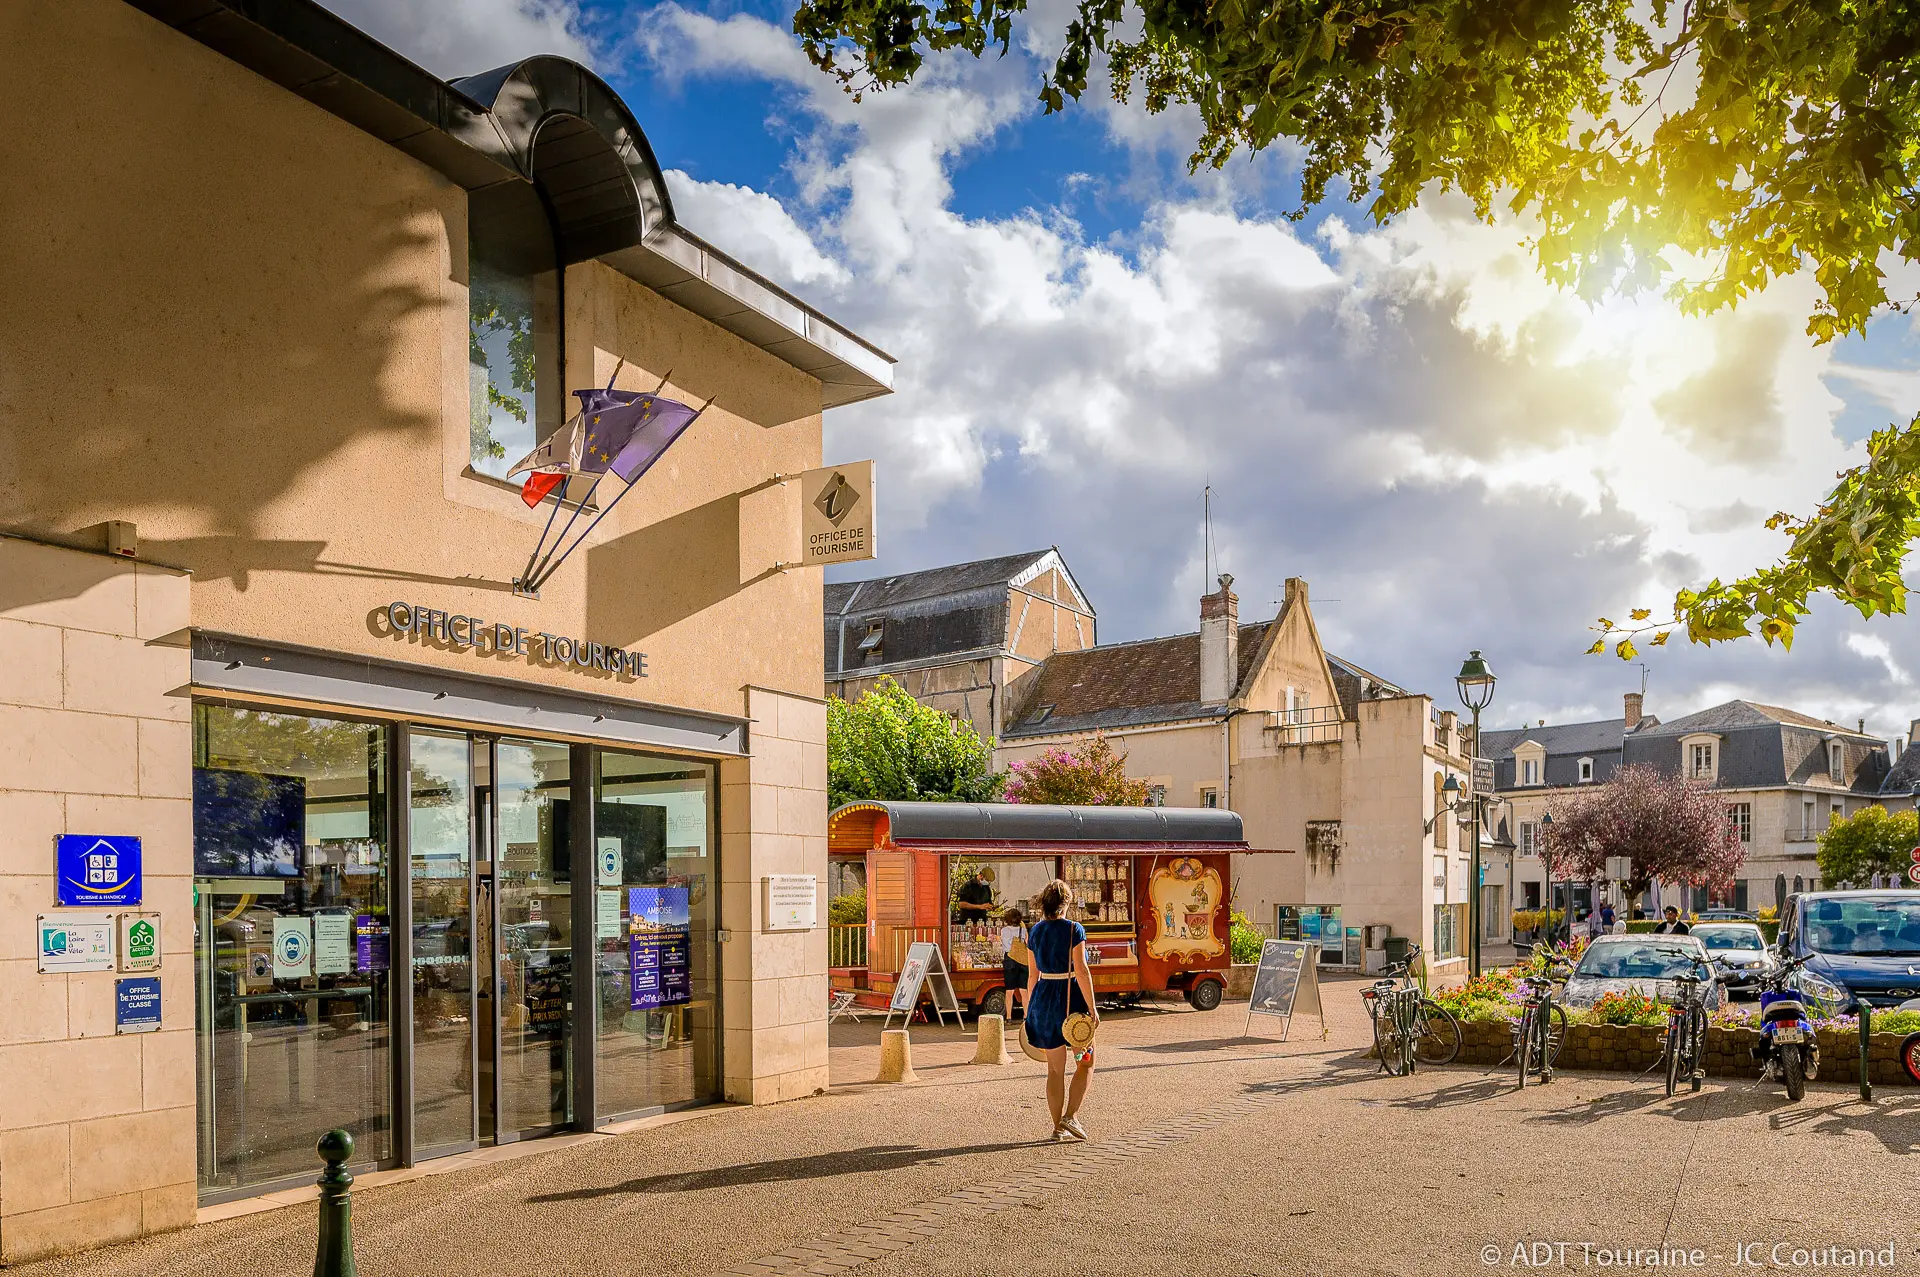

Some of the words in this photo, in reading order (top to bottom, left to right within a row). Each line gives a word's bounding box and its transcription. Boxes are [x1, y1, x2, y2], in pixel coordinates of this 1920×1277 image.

[810, 530, 847, 544] OFFICE
[849, 528, 864, 538] DE
[810, 540, 864, 556] TOURISME
[388, 601, 485, 647] OFFICE
[495, 623, 529, 655] DE
[539, 632, 649, 678] TOURISME
[508, 847, 537, 856] BOUTIQUE
[646, 906, 673, 915] AMBOISE
[129, 986, 151, 994] OFFICE
[128, 1000, 152, 1008] CLASSÉ
[532, 1012, 547, 1022] PRIX
